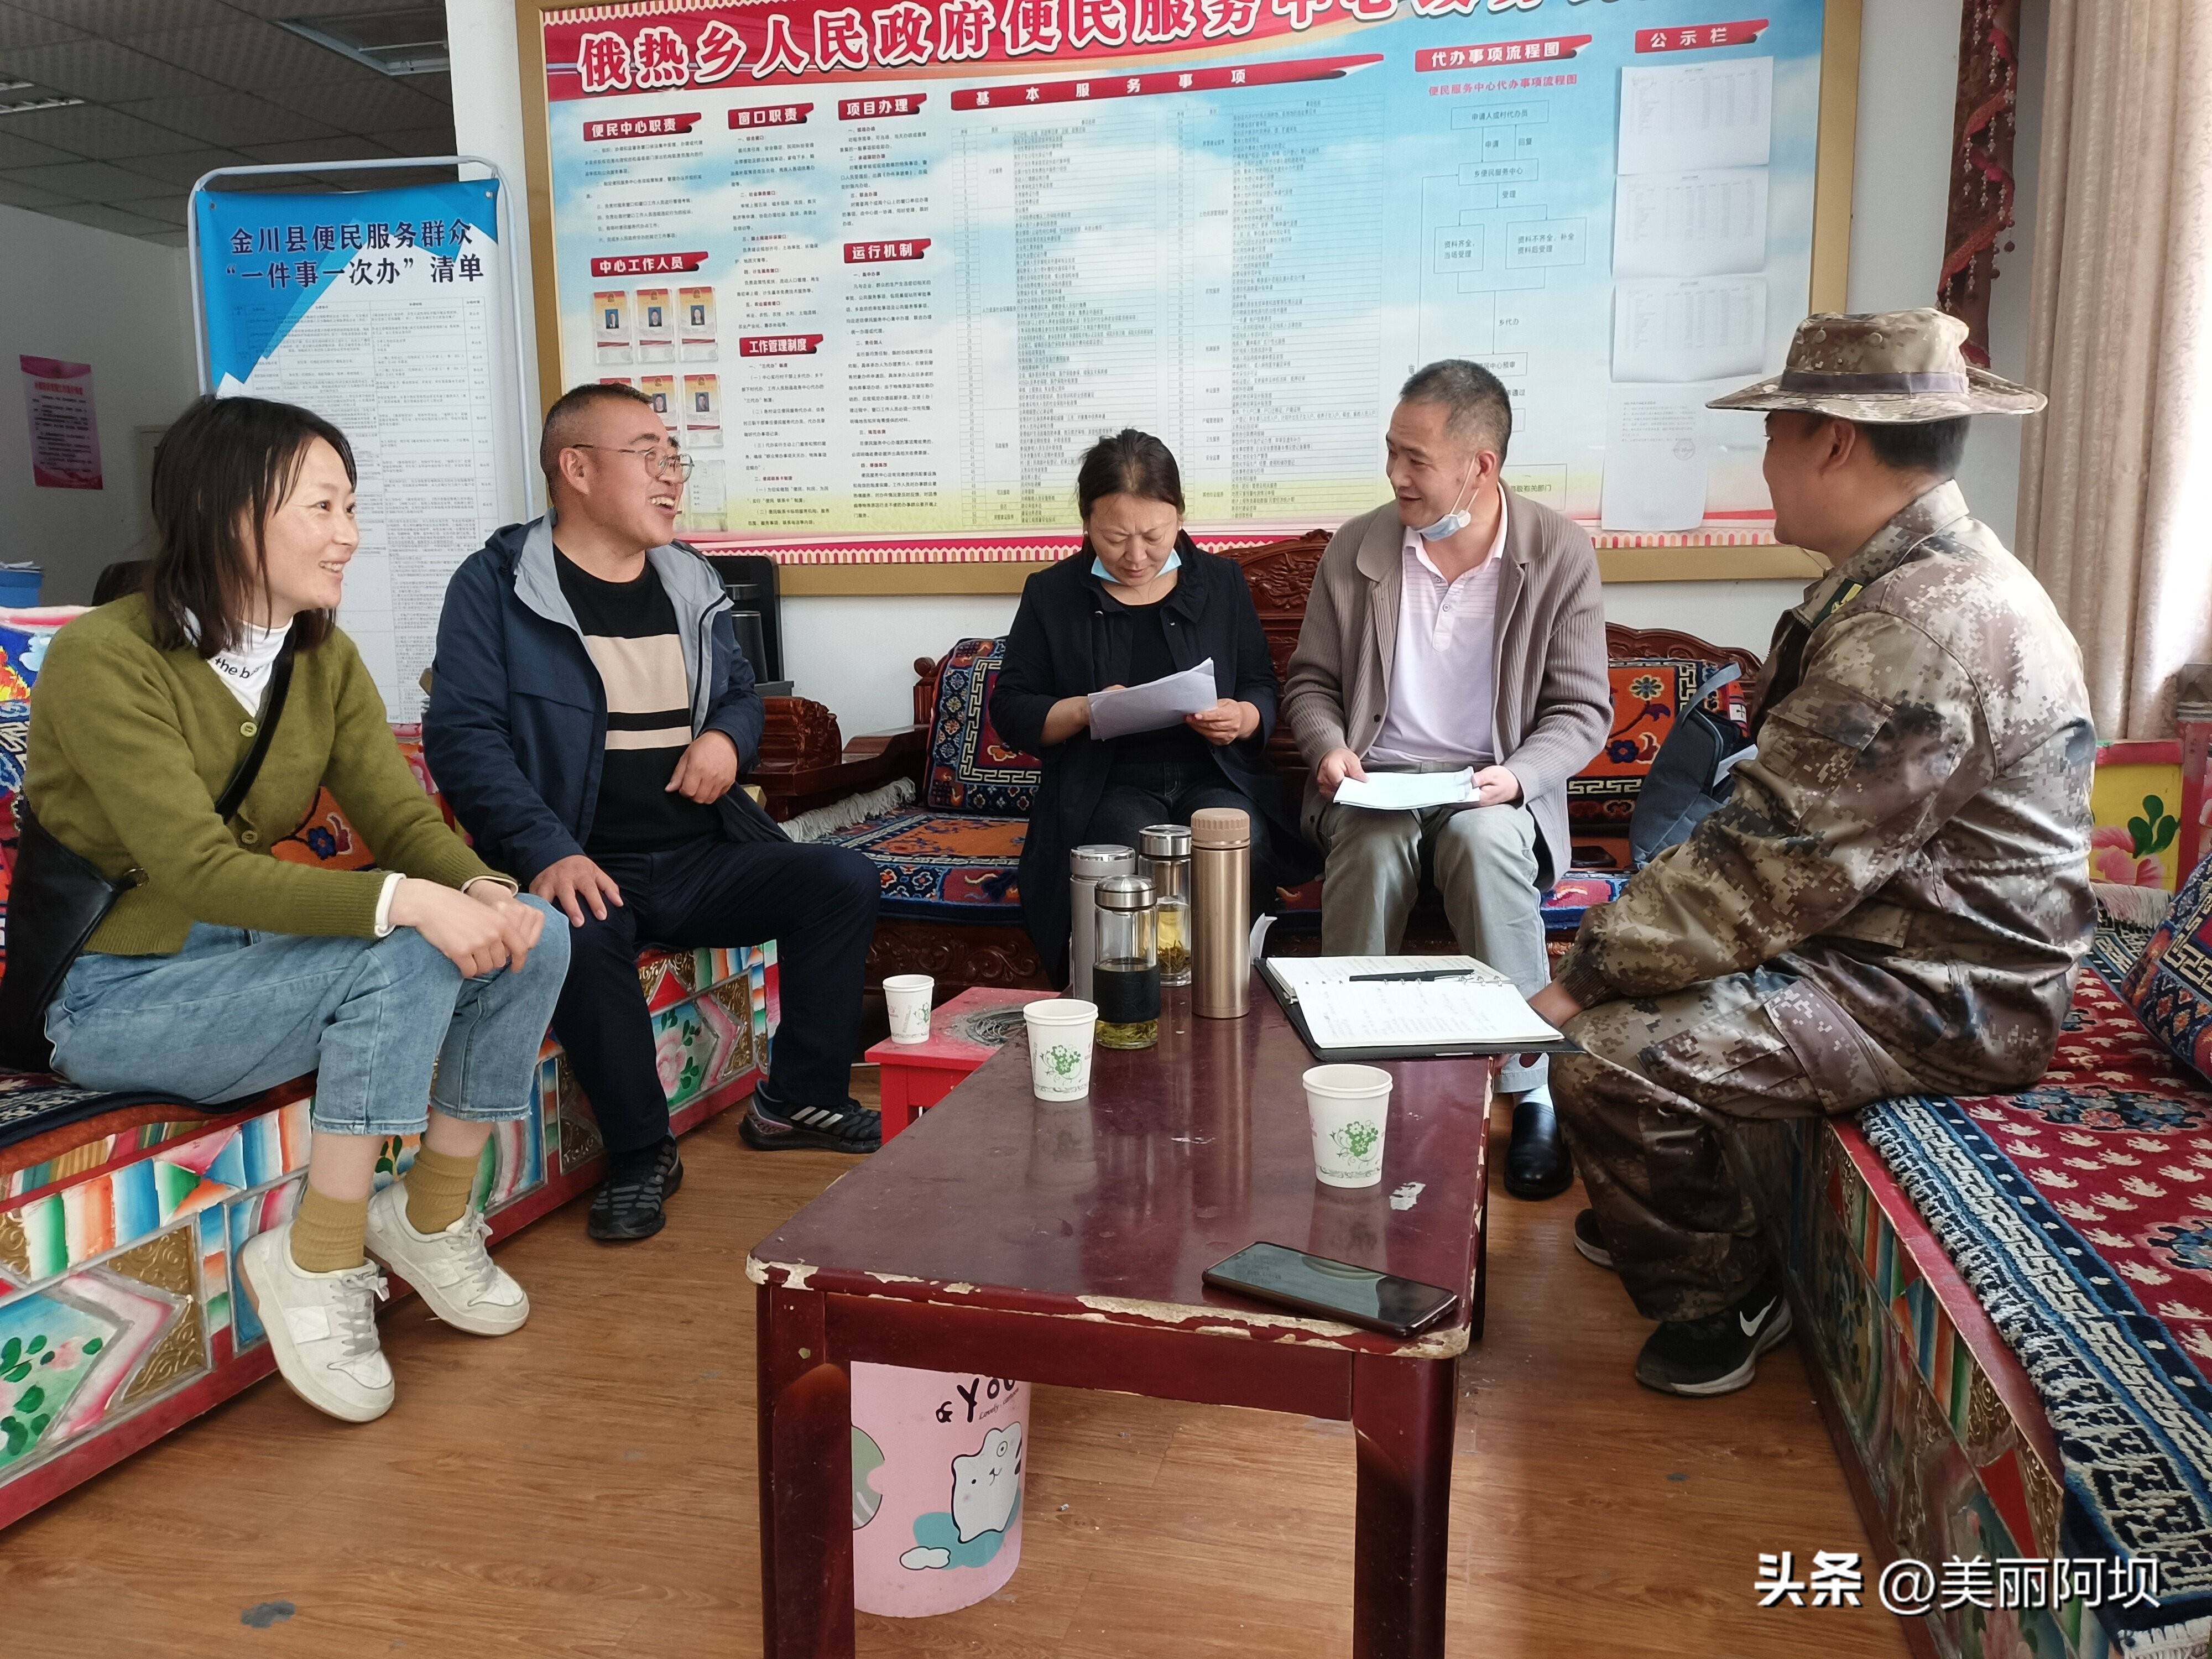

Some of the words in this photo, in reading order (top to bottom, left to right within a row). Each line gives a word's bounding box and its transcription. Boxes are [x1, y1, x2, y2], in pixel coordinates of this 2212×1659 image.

[1650, 27, 1727, 48] 公示栏
[1432, 41, 1559, 67] 代办事项流程图
[976, 69, 1246, 106] 基本服务事项
[1429, 74, 1577, 96] 便民服务中心代办事项流程图
[847, 98, 908, 116] 项目办理
[1472, 109, 1528, 121] 申请人或村代办员
[738, 108, 797, 125] 窗口职责
[592, 118, 676, 138] 便民中心职责
[1474, 168, 1523, 178] 乡便民服务中心
[229, 218, 472, 255] 金川县便民服务群众
[852, 243, 912, 259] 运行机制
[1444, 250, 1472, 259] 当场受理
[1517, 245, 1552, 254] 资料后受理
[599, 257, 684, 274] 中心工作人员
[1499, 318, 1519, 326] 乡代办
[749, 338, 807, 353] 工作管理制度
[1477, 361, 1515, 370] 民中心预审
[215, 658, 238, 675] the
